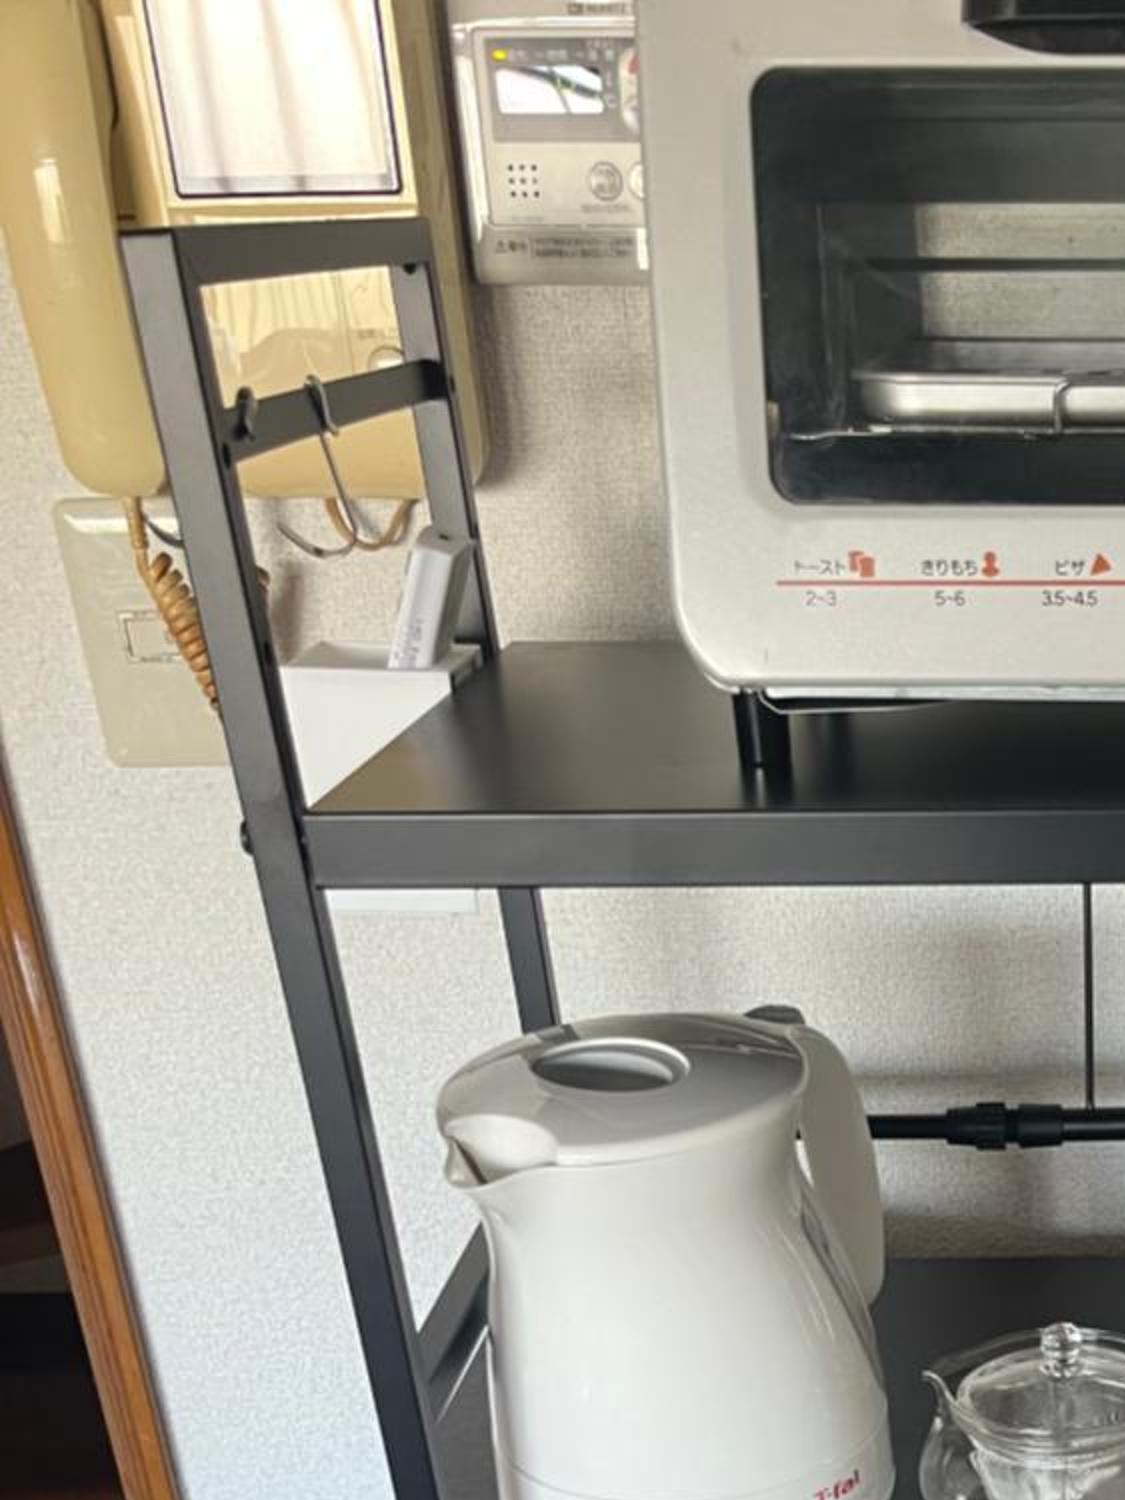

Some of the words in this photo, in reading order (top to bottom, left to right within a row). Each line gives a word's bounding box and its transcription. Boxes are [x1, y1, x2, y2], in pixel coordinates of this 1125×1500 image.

[794, 559, 846, 576] トースト
[920, 559, 978, 577] きりもち
